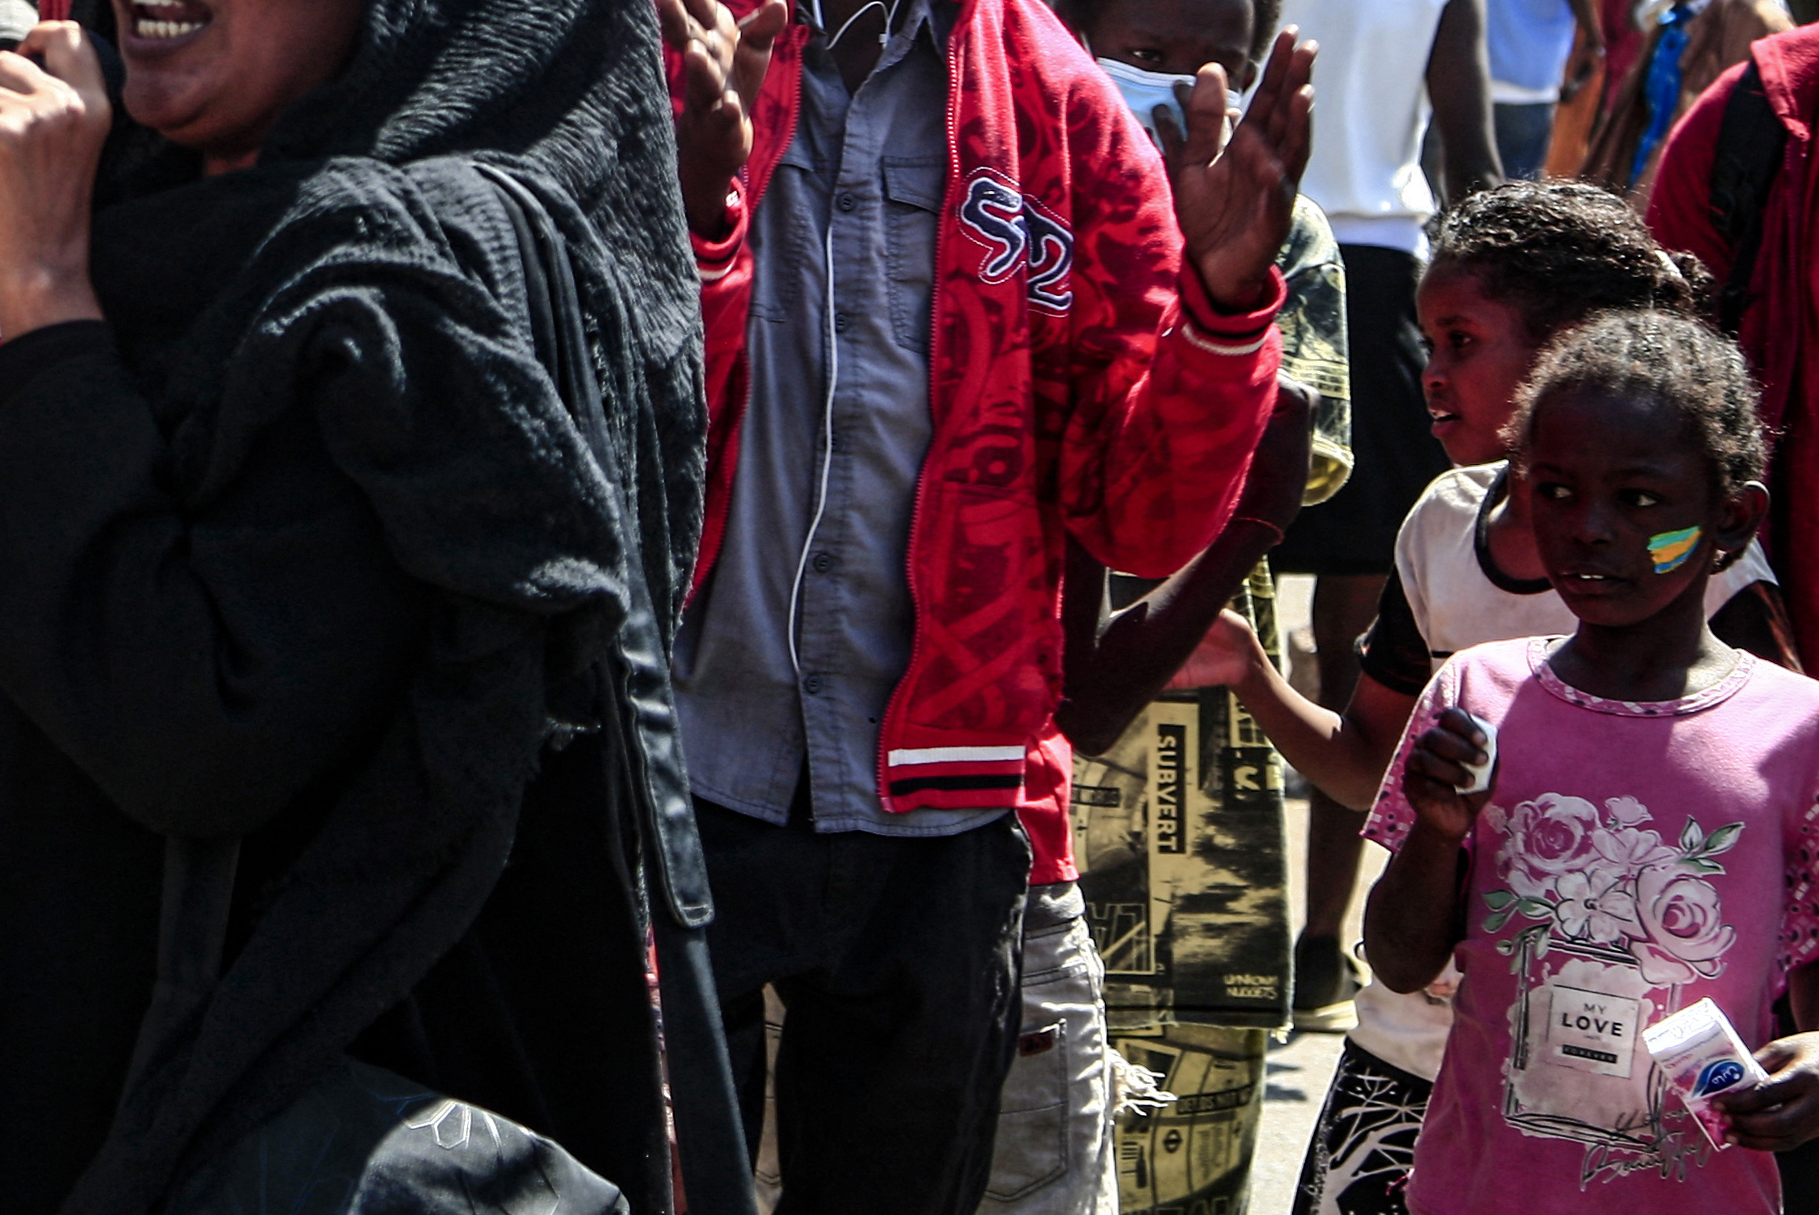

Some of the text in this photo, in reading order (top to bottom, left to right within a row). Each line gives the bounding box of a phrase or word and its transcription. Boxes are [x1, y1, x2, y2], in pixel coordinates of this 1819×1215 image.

[1157, 734, 1178, 852] SUBVERT
[1584, 1003, 1607, 1015] MY
[1562, 1012, 1623, 1037] LOVE
